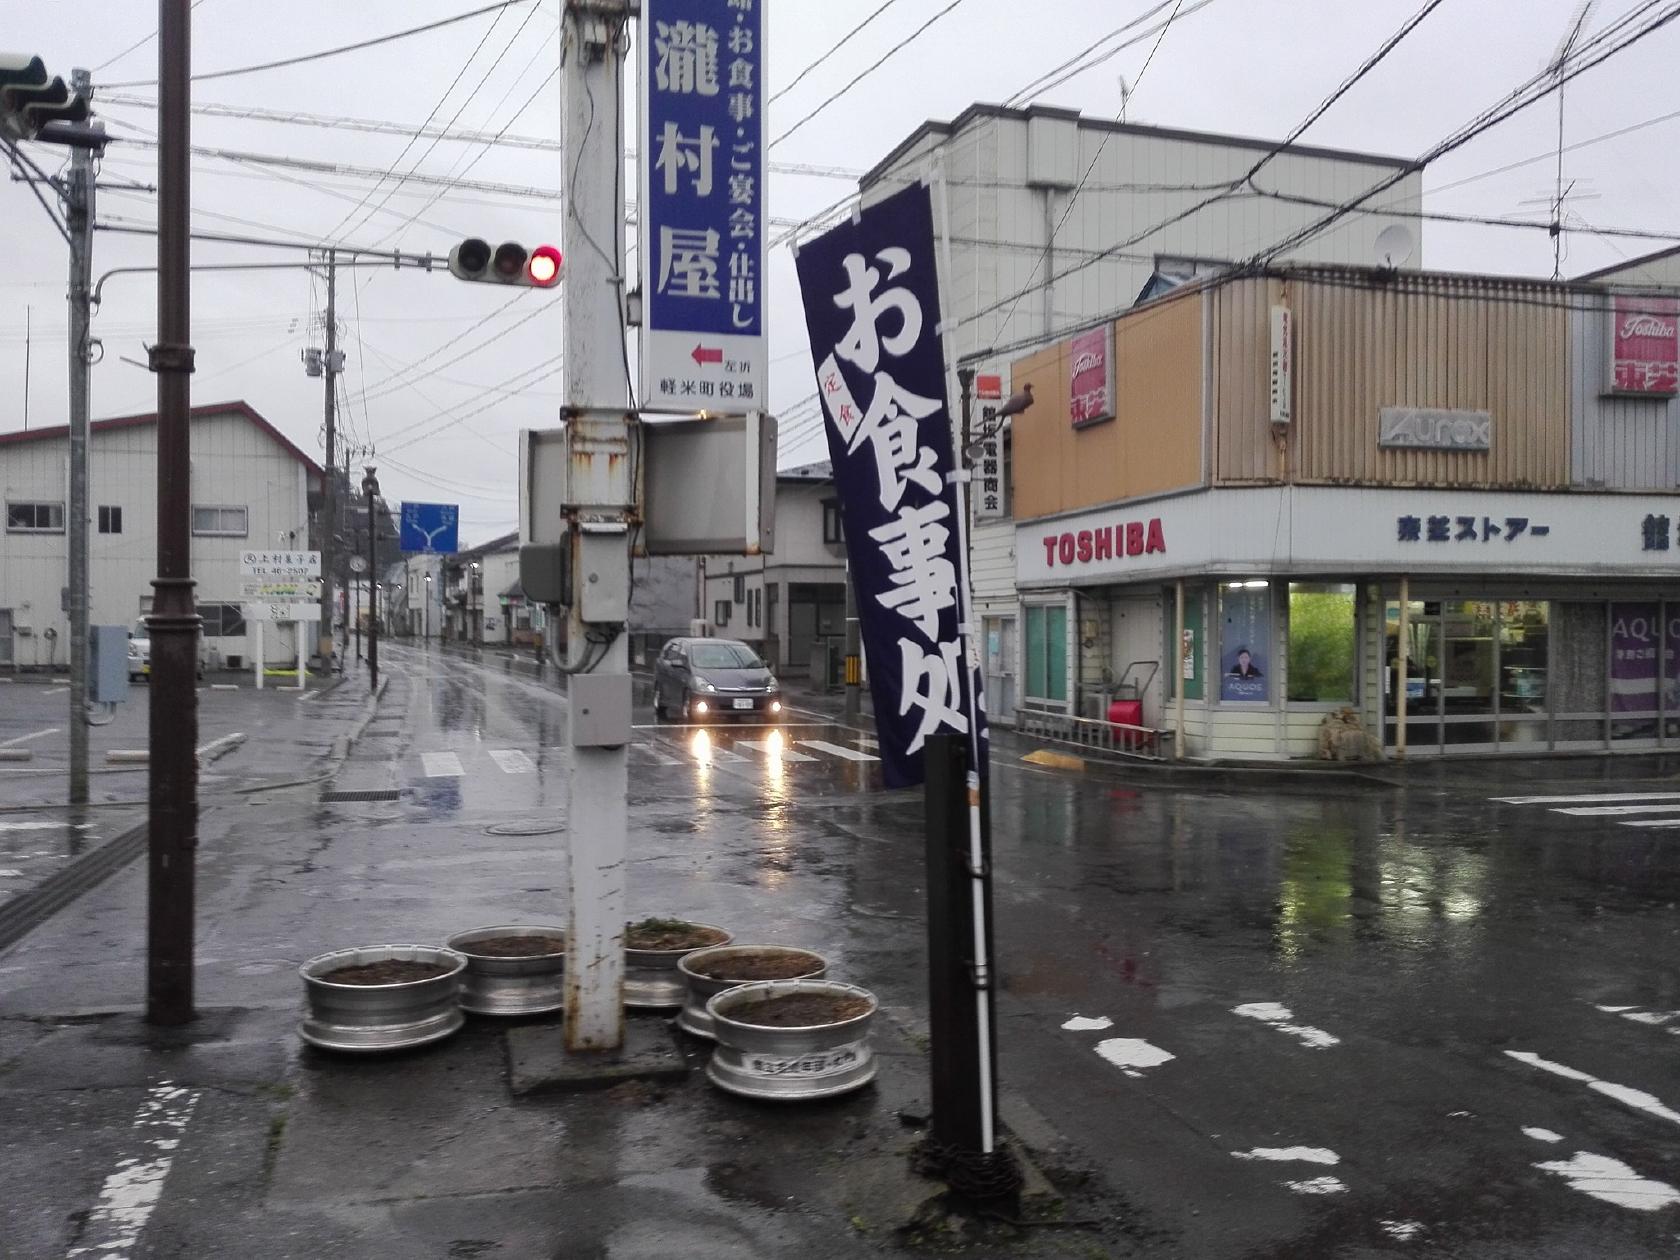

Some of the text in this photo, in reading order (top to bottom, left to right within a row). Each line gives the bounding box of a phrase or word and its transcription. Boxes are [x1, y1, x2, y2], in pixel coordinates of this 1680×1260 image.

[655, 20, 721, 299] 瀧村屋
[660, 377, 754, 399] 軽米町役場
[1390, 409, 1489, 443] Aurex
[833, 246, 968, 756] お食事処
[1043, 518, 1166, 567] TOSHIBA
[1398, 515, 1550, 542] 東芝ストアー
